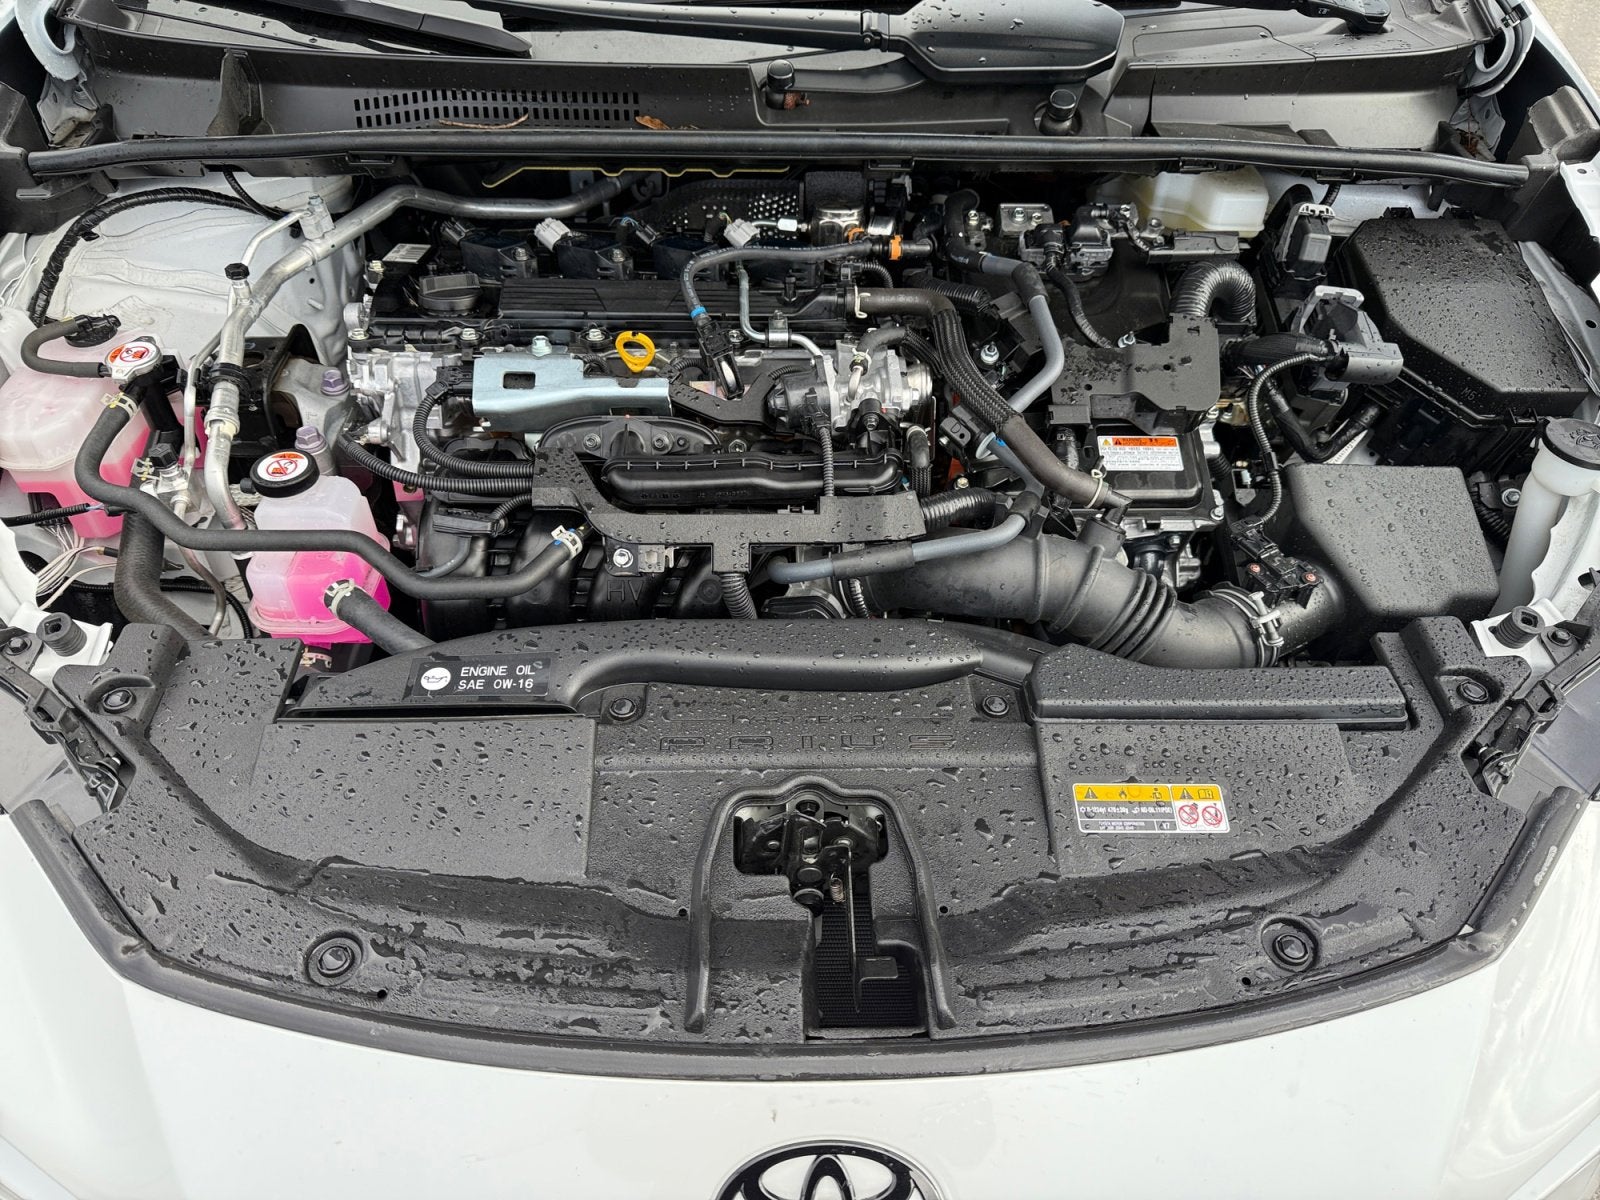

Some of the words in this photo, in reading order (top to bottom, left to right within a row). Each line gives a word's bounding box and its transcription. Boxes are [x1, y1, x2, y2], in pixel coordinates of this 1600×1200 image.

[607, 580, 643, 601] HV
[460, 666, 508, 677] ENGINE
[516, 665, 536, 675] OIL
[458, 680, 485, 690] SAE
[493, 678, 534, 689] 0W-16
[660, 735, 954, 750] PRIUS
